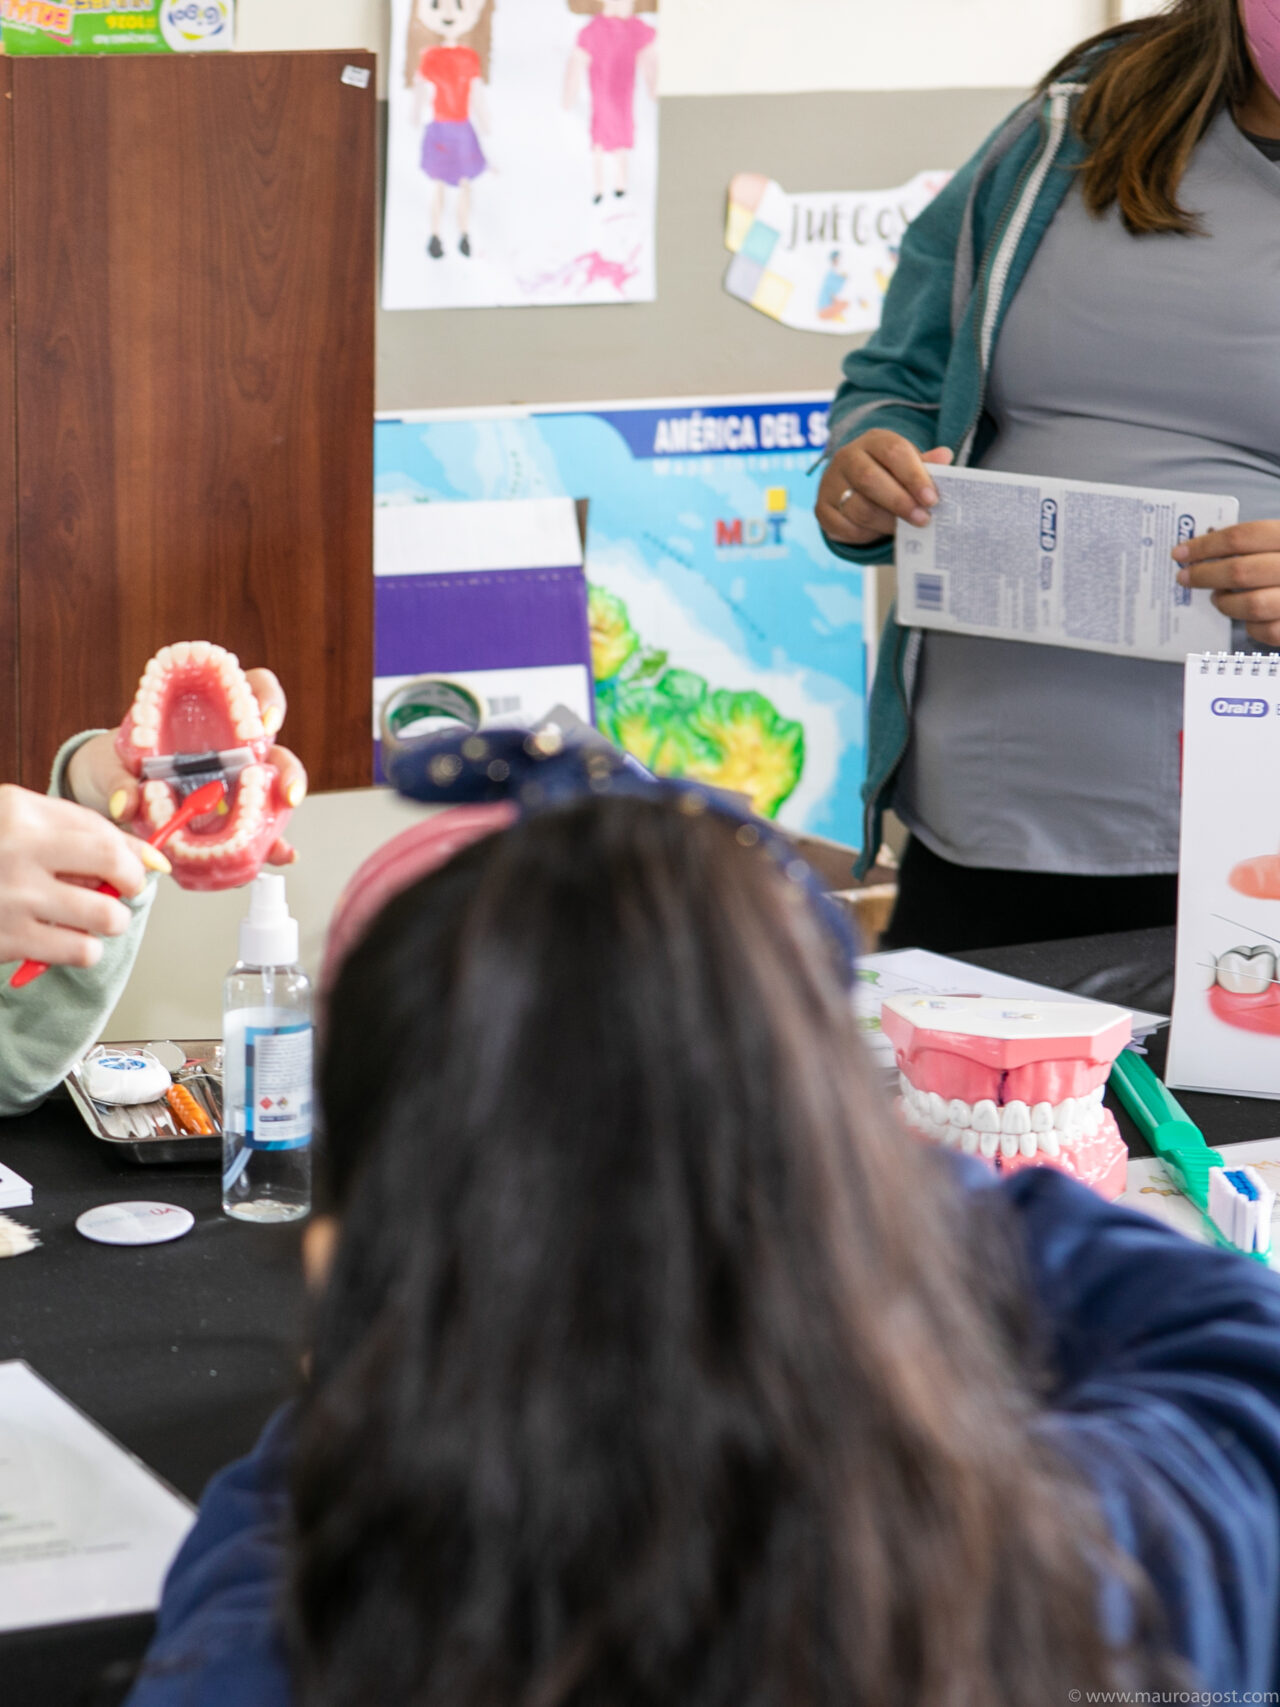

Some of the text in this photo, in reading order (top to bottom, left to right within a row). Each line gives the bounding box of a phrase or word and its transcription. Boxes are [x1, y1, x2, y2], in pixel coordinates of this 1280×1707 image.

[654, 410, 758, 453] AMÉRICA
[760, 413, 806, 449] DEL
[716, 518, 787, 546] MDT
[1215, 700, 1265, 715] Oral-B
